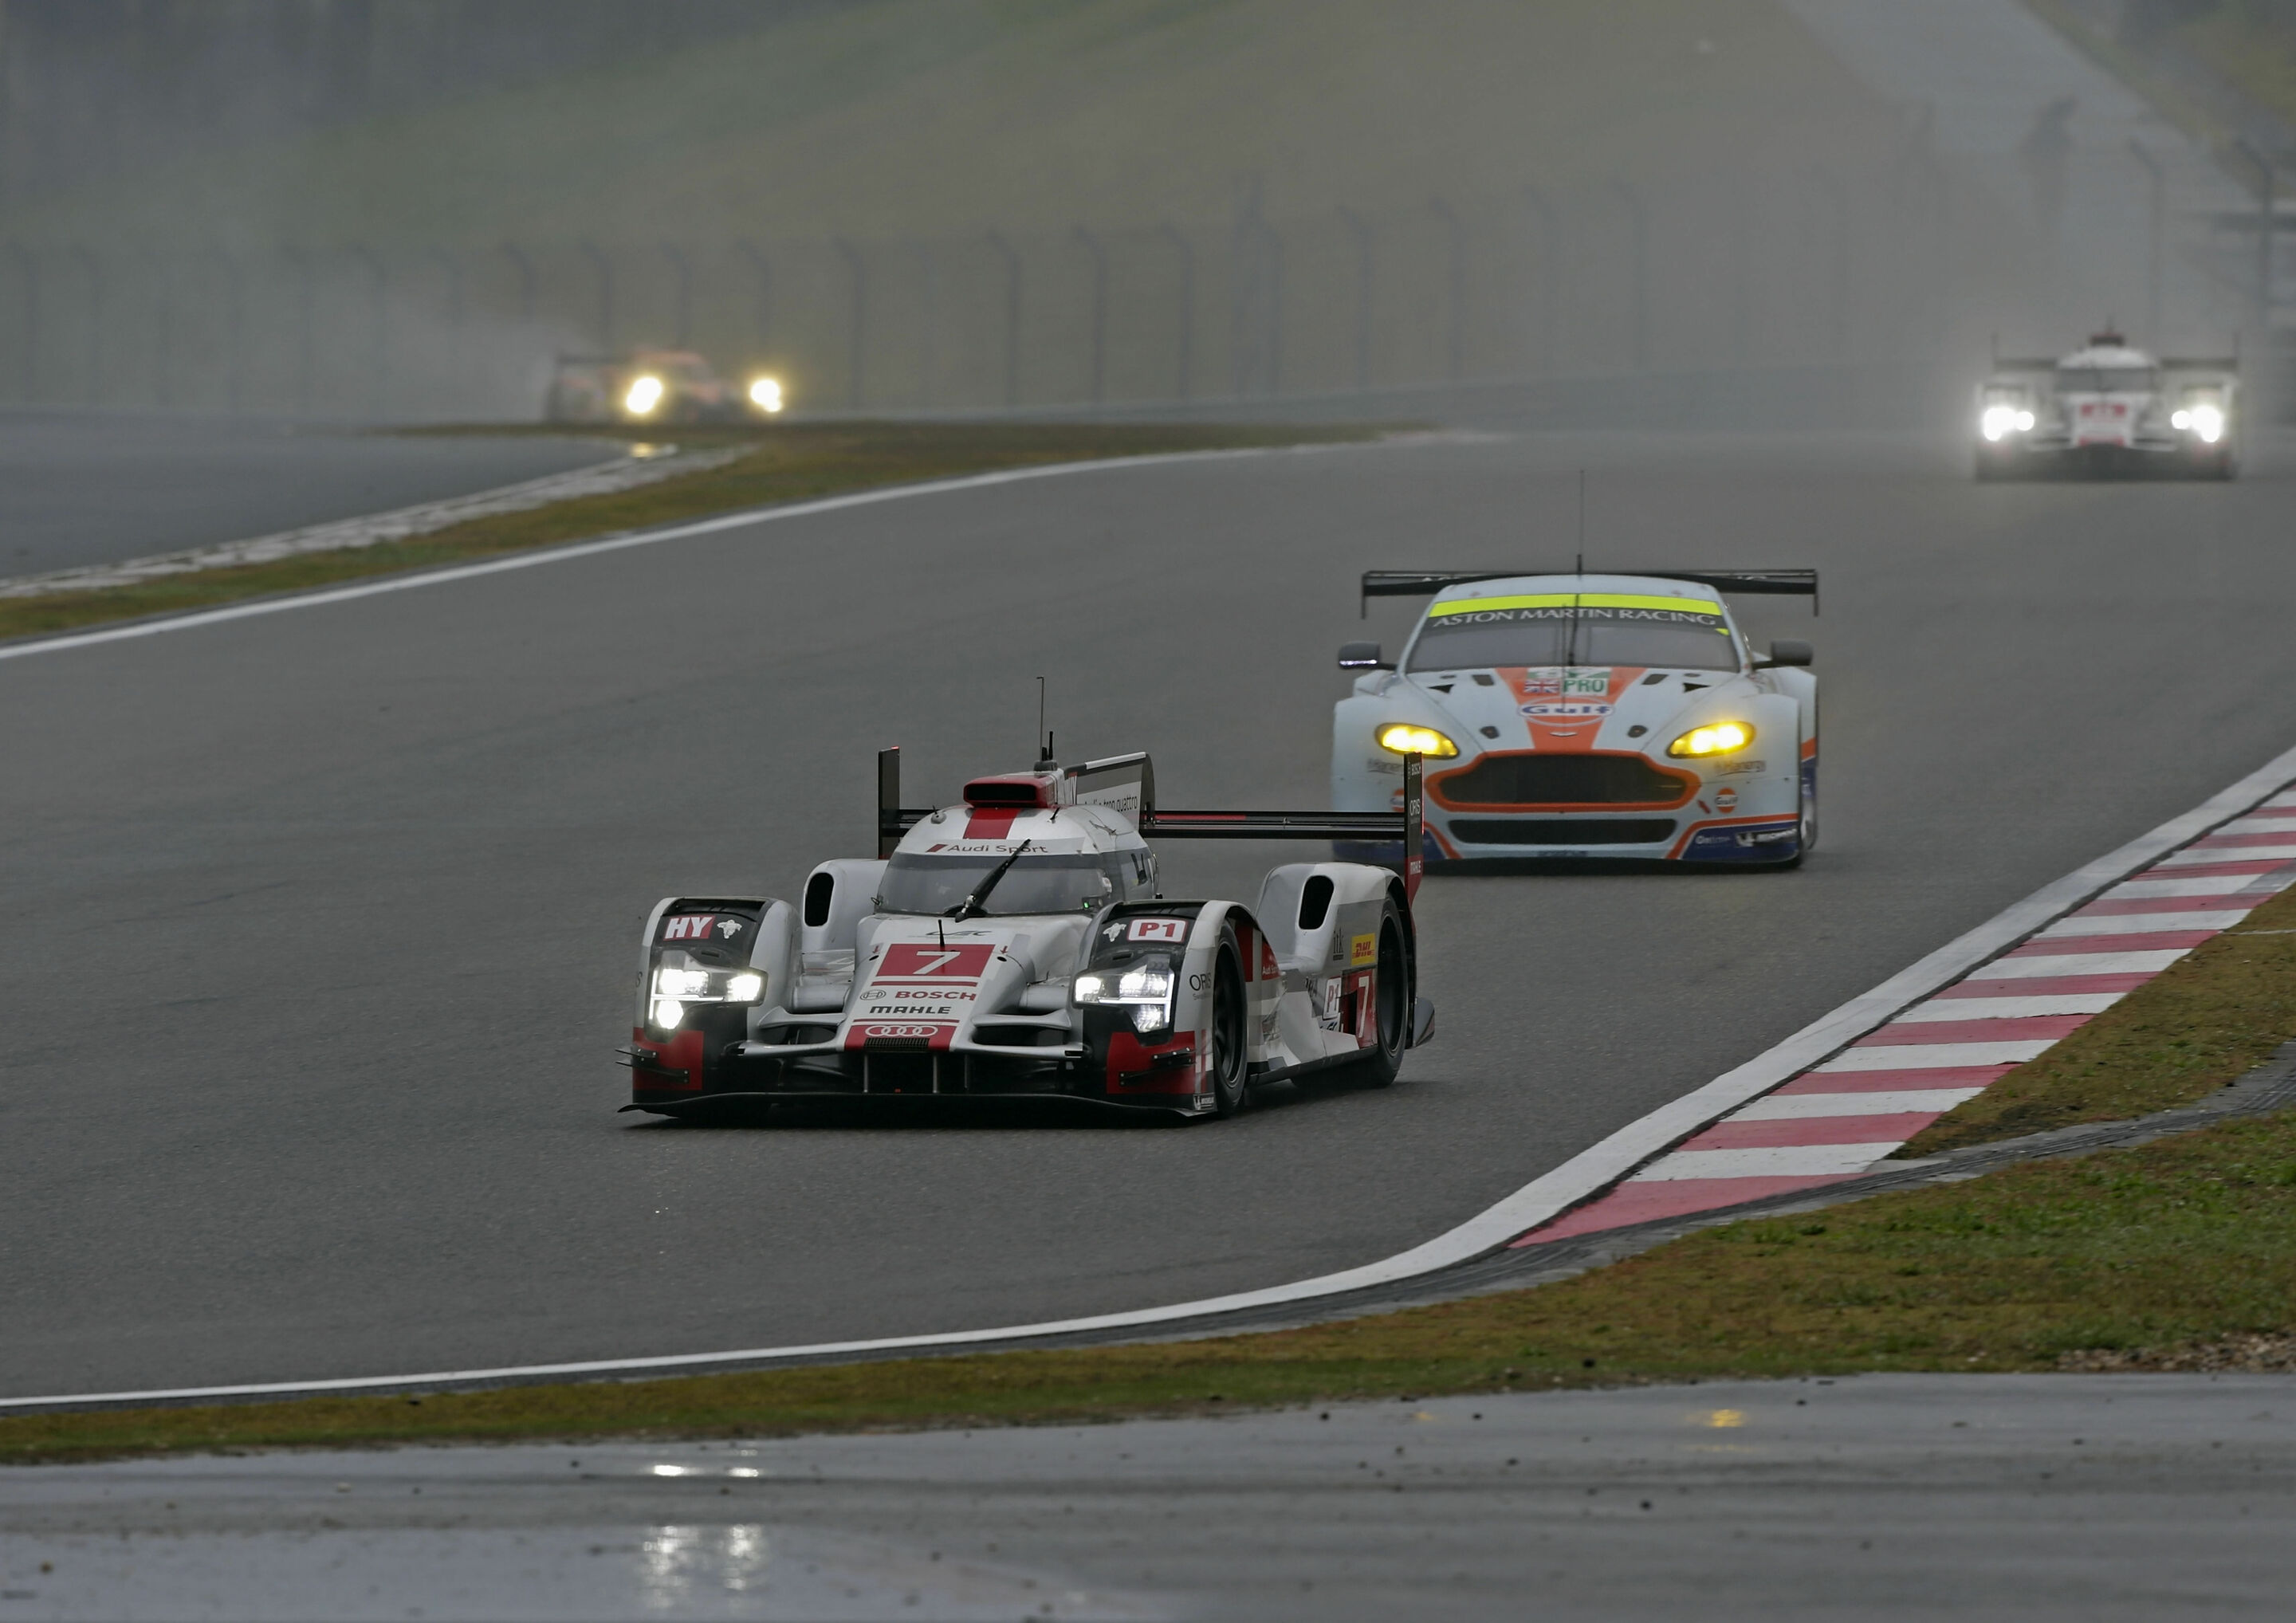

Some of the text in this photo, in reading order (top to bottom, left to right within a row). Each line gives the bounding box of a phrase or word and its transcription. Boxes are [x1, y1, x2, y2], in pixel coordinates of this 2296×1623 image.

[1433, 607, 1716, 627] ASTON MARTIN RACING
[1563, 679, 1605, 692] PRO
[1521, 705, 1611, 714] Gulf
[1117, 795, 1138, 812] quattro
[1409, 798, 1421, 816] ORIS
[996, 845, 1048, 854] Sport
[664, 917, 713, 939] HY
[1138, 922, 1176, 937] P1
[913, 951, 961, 975] 7
[894, 991, 977, 1001] BOSCH
[1327, 984, 1340, 1012] P1
[869, 1006, 952, 1015] MAHLE
[1358, 976, 1370, 1039] 7
